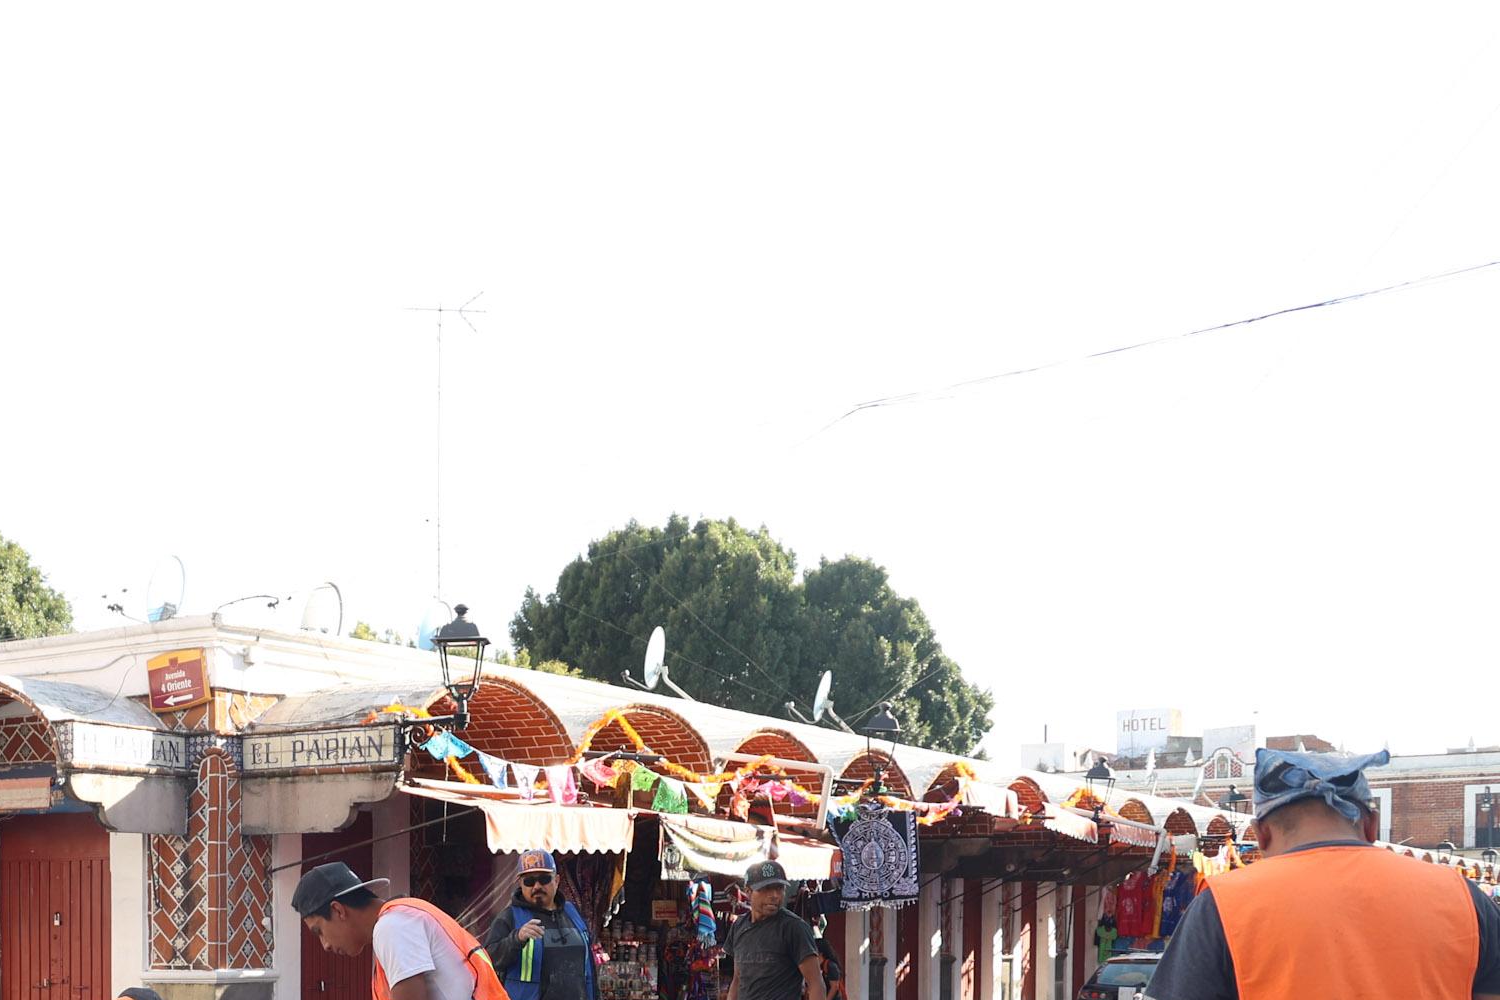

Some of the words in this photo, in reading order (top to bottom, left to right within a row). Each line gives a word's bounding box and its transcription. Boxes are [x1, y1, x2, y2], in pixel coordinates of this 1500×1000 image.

[165, 669, 186, 680] Avenida
[161, 683, 167, 693] 4
[167, 678, 192, 692] Oriente
[1122, 717, 1166, 732] HOTEL
[251, 742, 278, 765] EL
